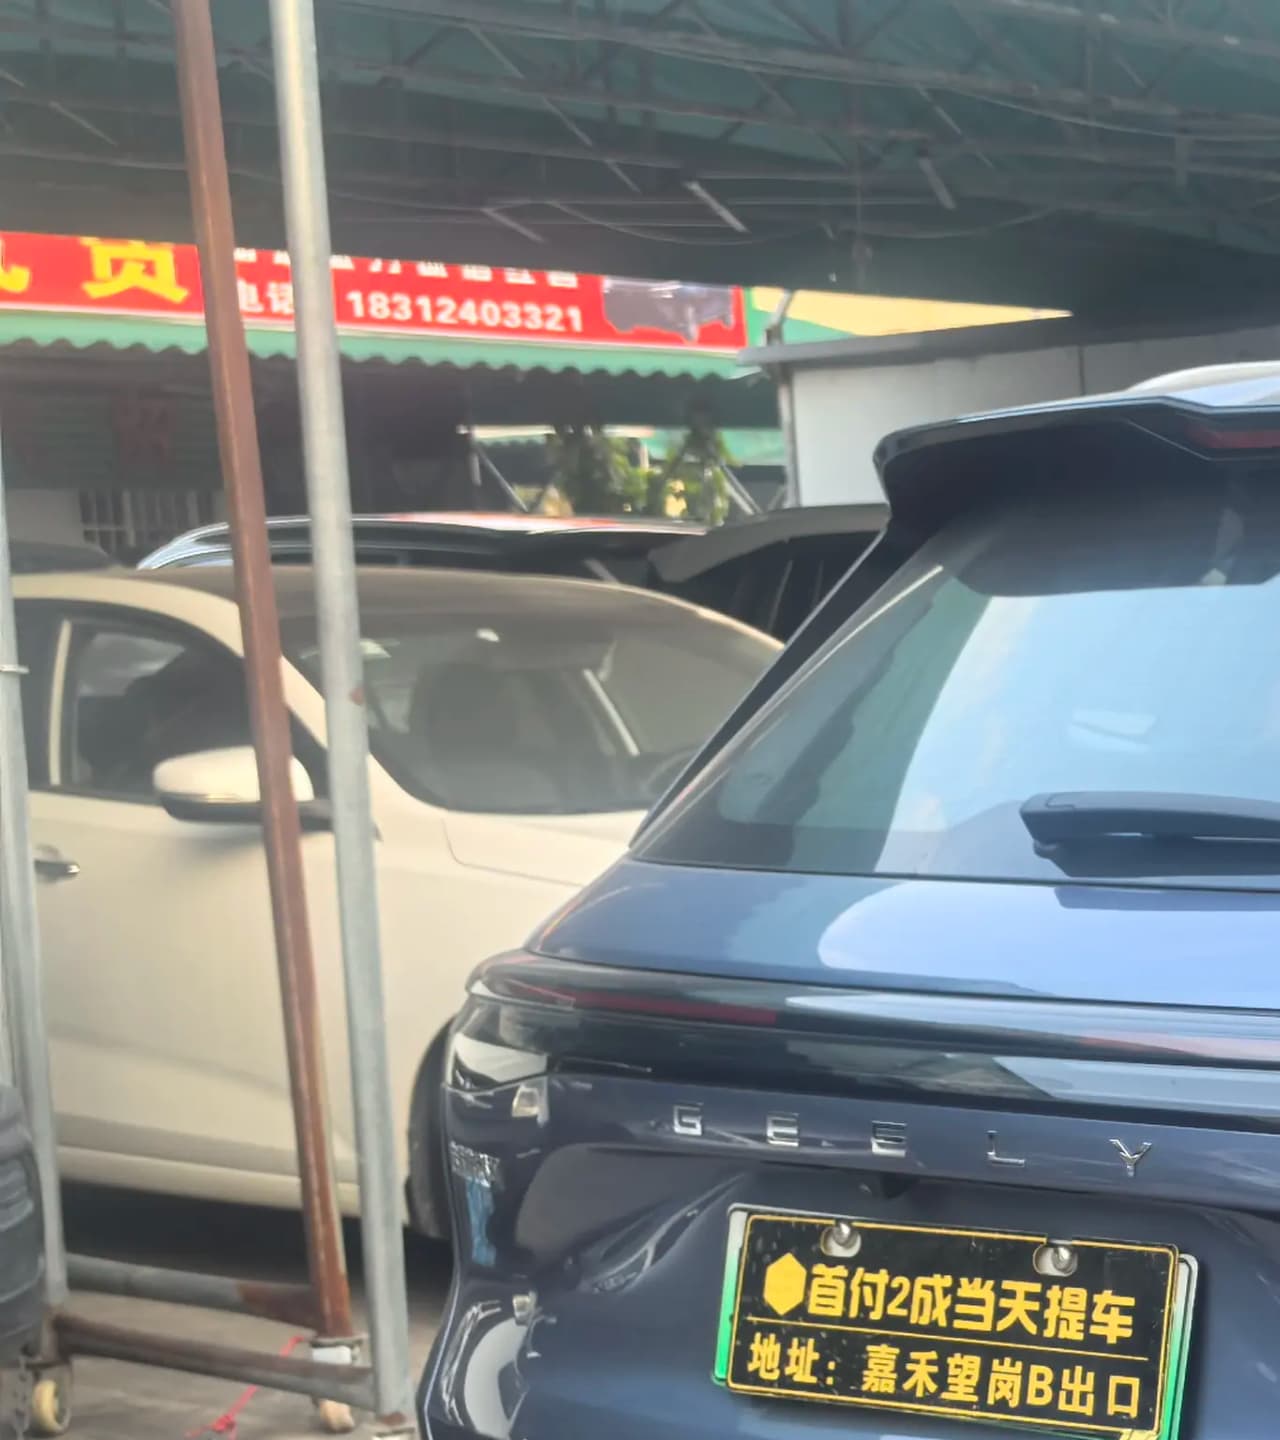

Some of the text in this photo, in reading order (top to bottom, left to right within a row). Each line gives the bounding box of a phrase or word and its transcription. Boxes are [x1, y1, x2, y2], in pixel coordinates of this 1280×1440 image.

[346, 289, 584, 333] 18312403321
[673, 1103, 1152, 1177] GEELY
[808, 1263, 1136, 1344] 首付2成当天提车
